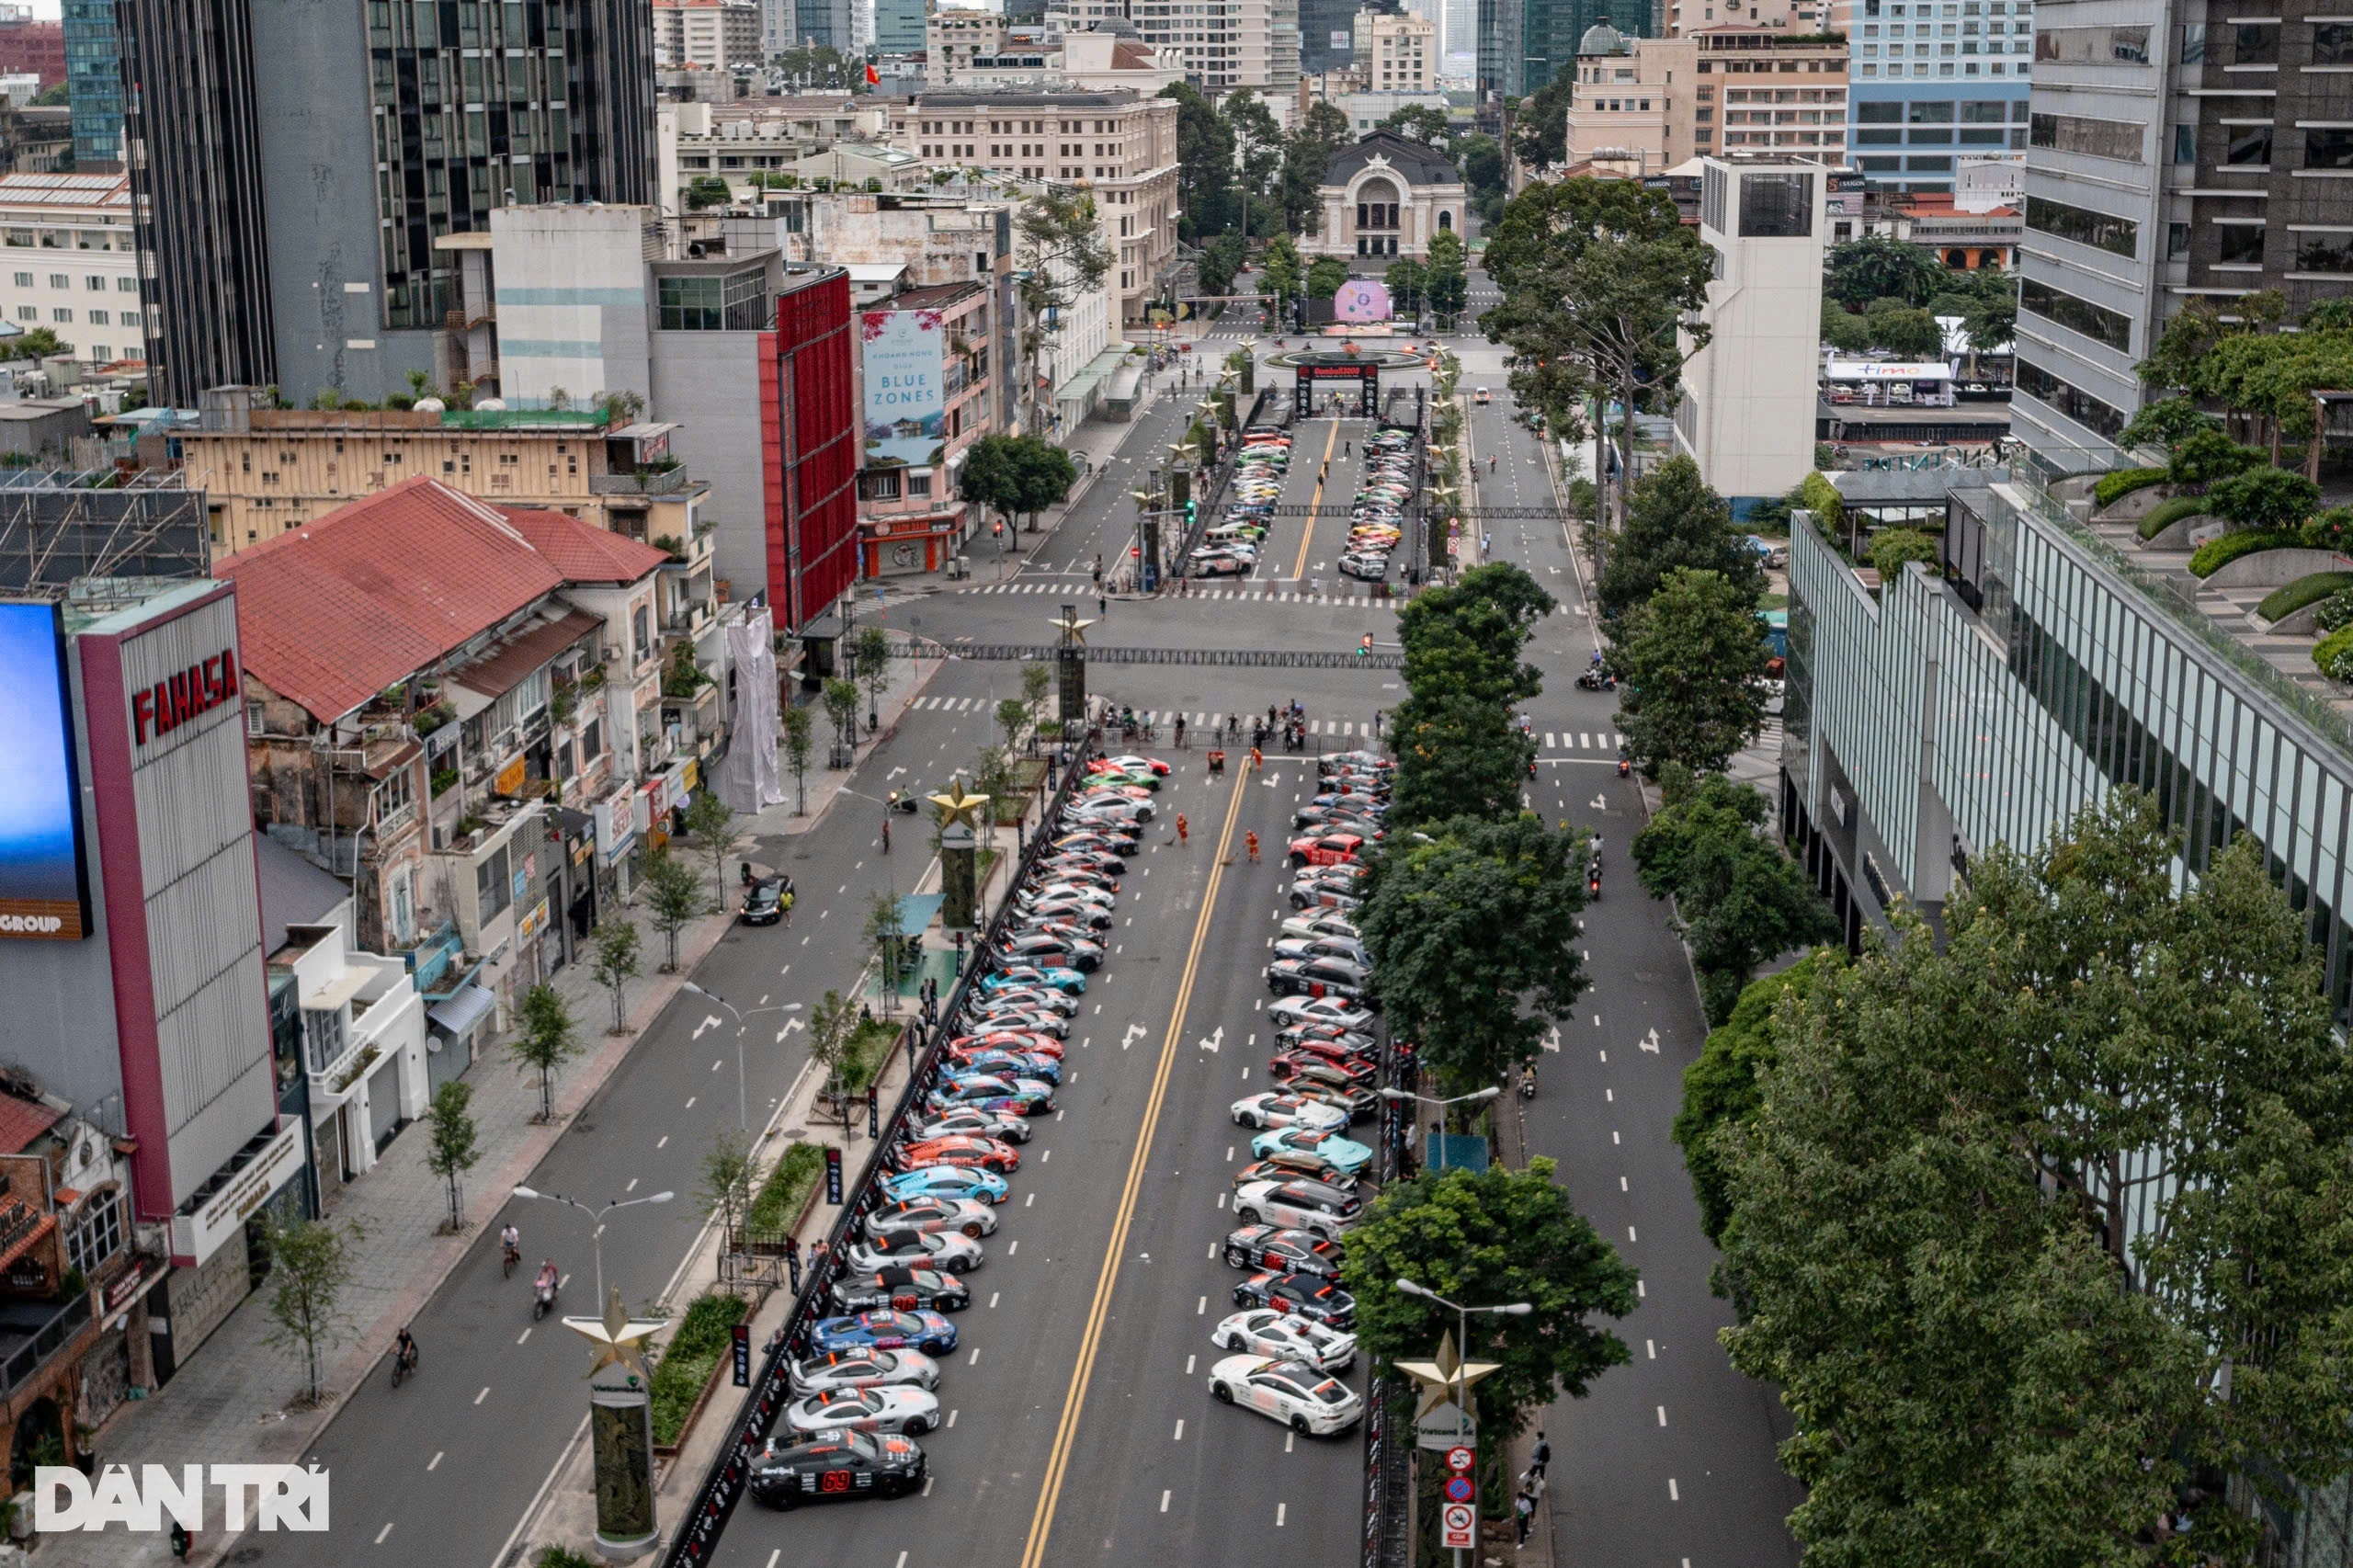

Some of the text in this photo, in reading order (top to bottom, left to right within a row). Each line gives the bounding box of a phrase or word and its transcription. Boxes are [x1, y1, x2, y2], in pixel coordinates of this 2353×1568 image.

[1858, 364, 1920, 375] timo
[881, 374, 926, 389] BLUE
[874, 390, 934, 405] ZONES
[131, 648, 239, 747] FAHASA
[0, 915, 62, 933] GROUP
[822, 1470, 850, 1493] 69
